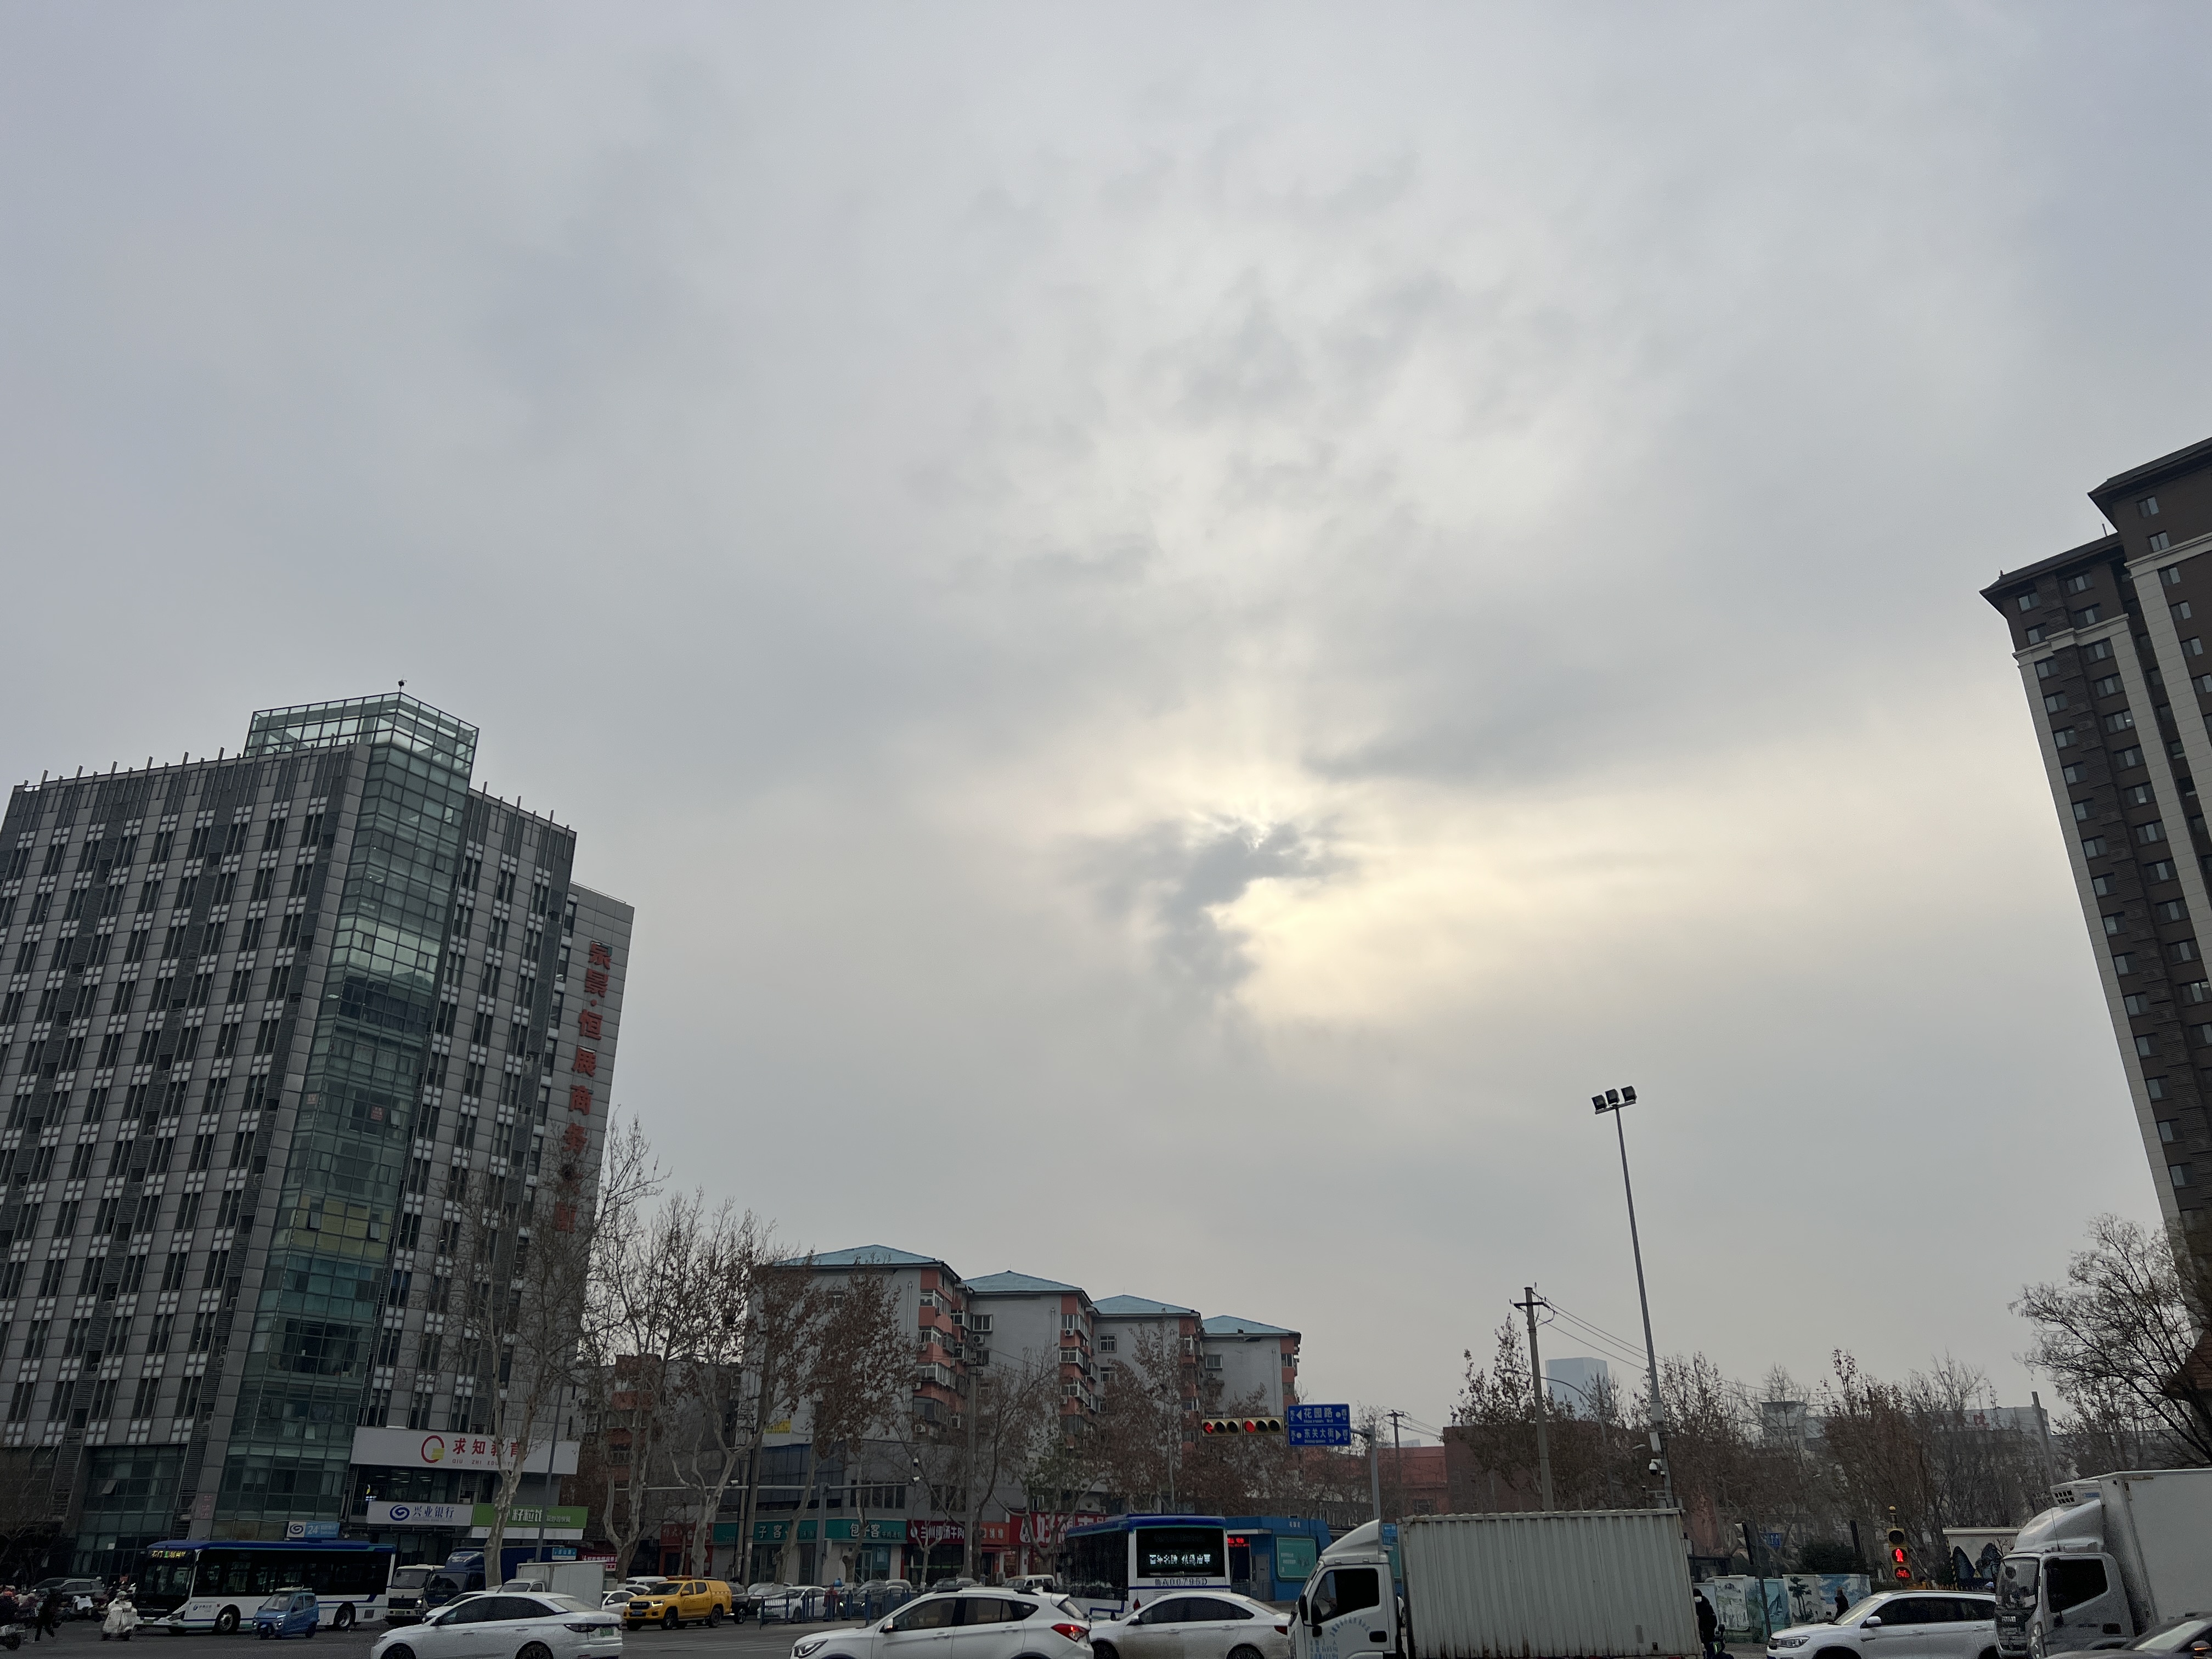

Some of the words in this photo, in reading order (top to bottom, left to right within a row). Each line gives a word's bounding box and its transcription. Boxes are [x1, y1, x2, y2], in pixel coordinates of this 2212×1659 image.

[1304, 1407, 1333, 1418] 花园路
[1304, 1427, 1334, 1438] 东关大街
[413, 1505, 455, 1519] 兴业银行
[307, 1525, 318, 1535] 24
